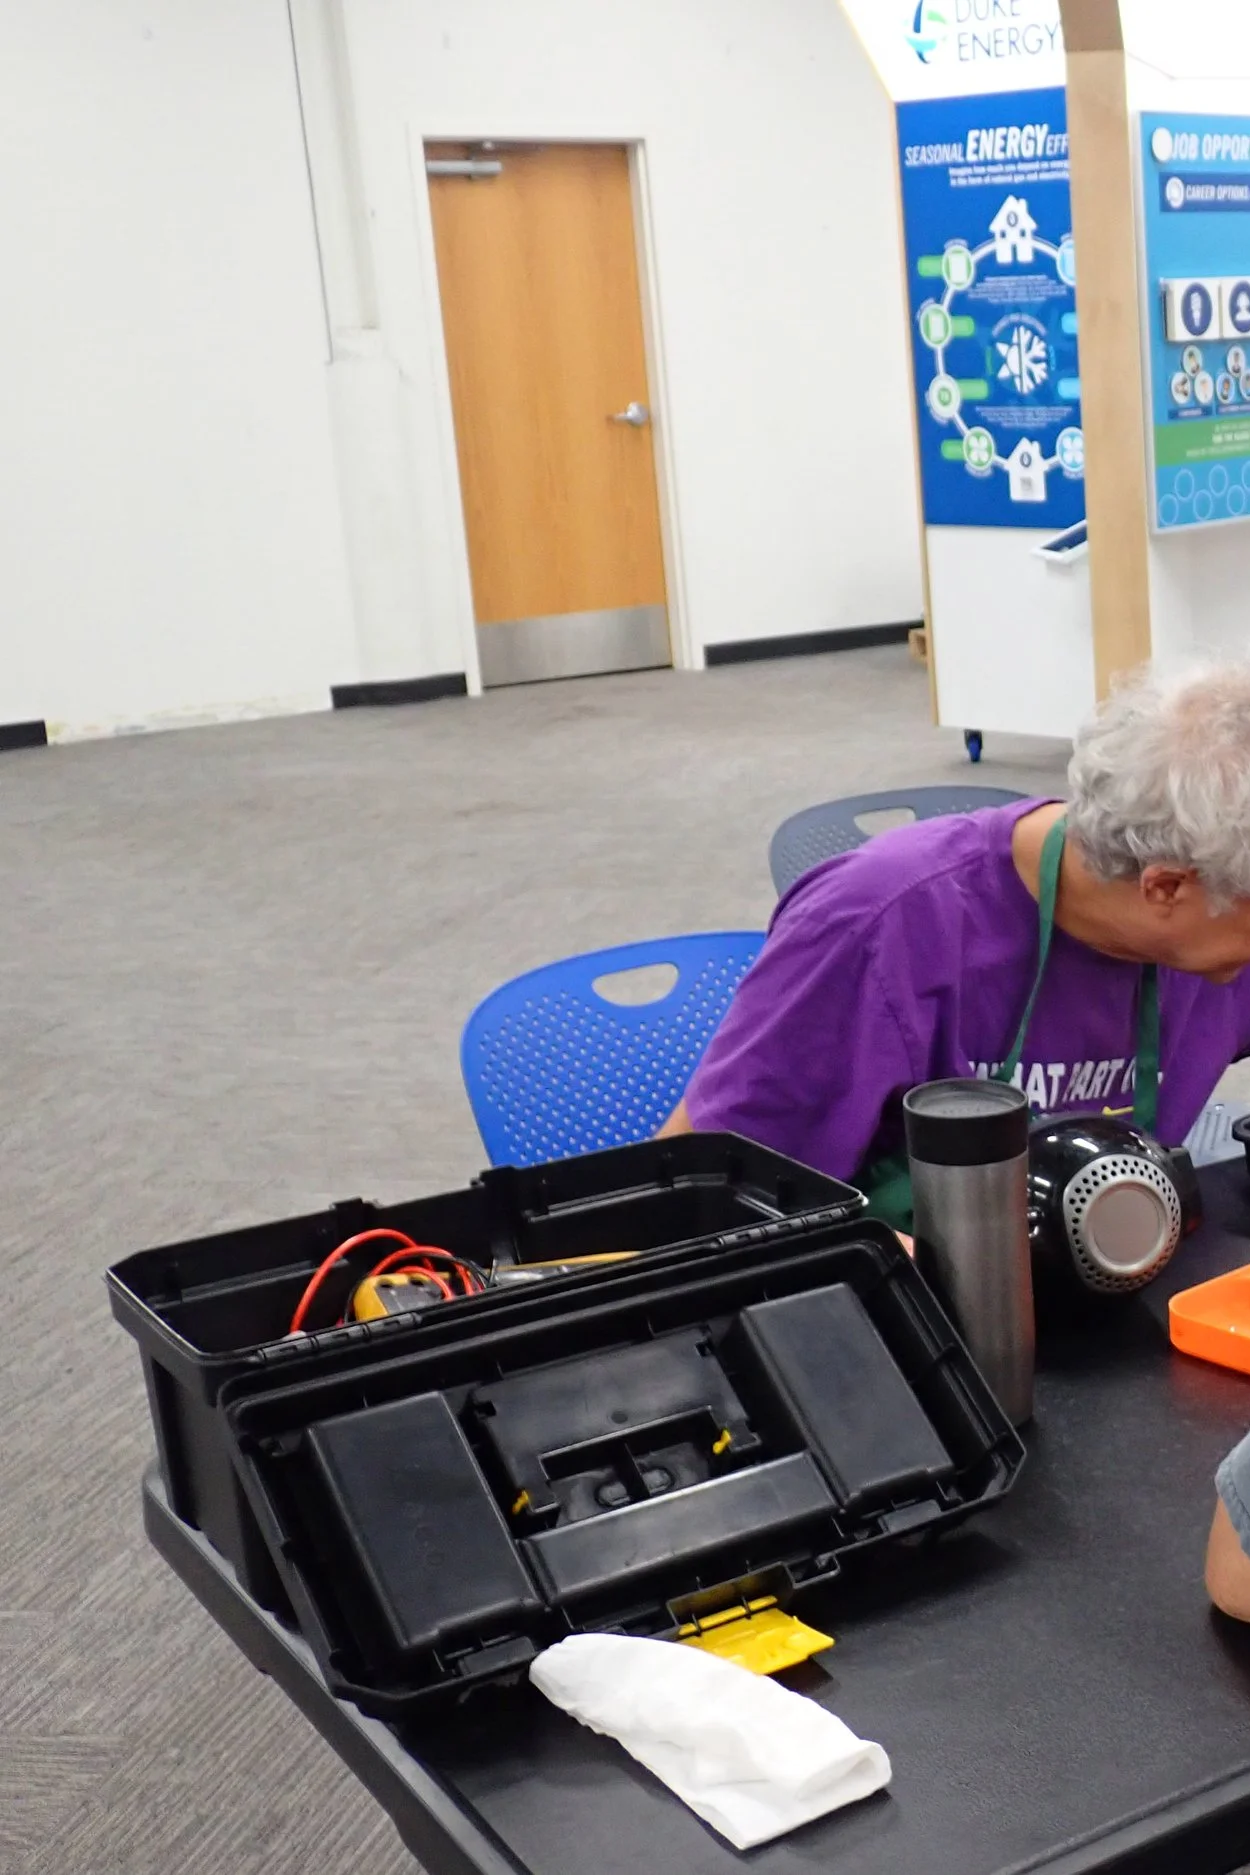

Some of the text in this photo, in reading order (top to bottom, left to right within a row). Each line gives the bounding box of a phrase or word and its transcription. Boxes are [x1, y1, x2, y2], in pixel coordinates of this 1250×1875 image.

[956, 0, 1020, 23] DUKE
[957, 22, 1059, 62] ENERGY
[904, 142, 964, 167] SEASONAL
[965, 123, 1049, 162] ENERGY
[1172, 131, 1198, 161] JOB
